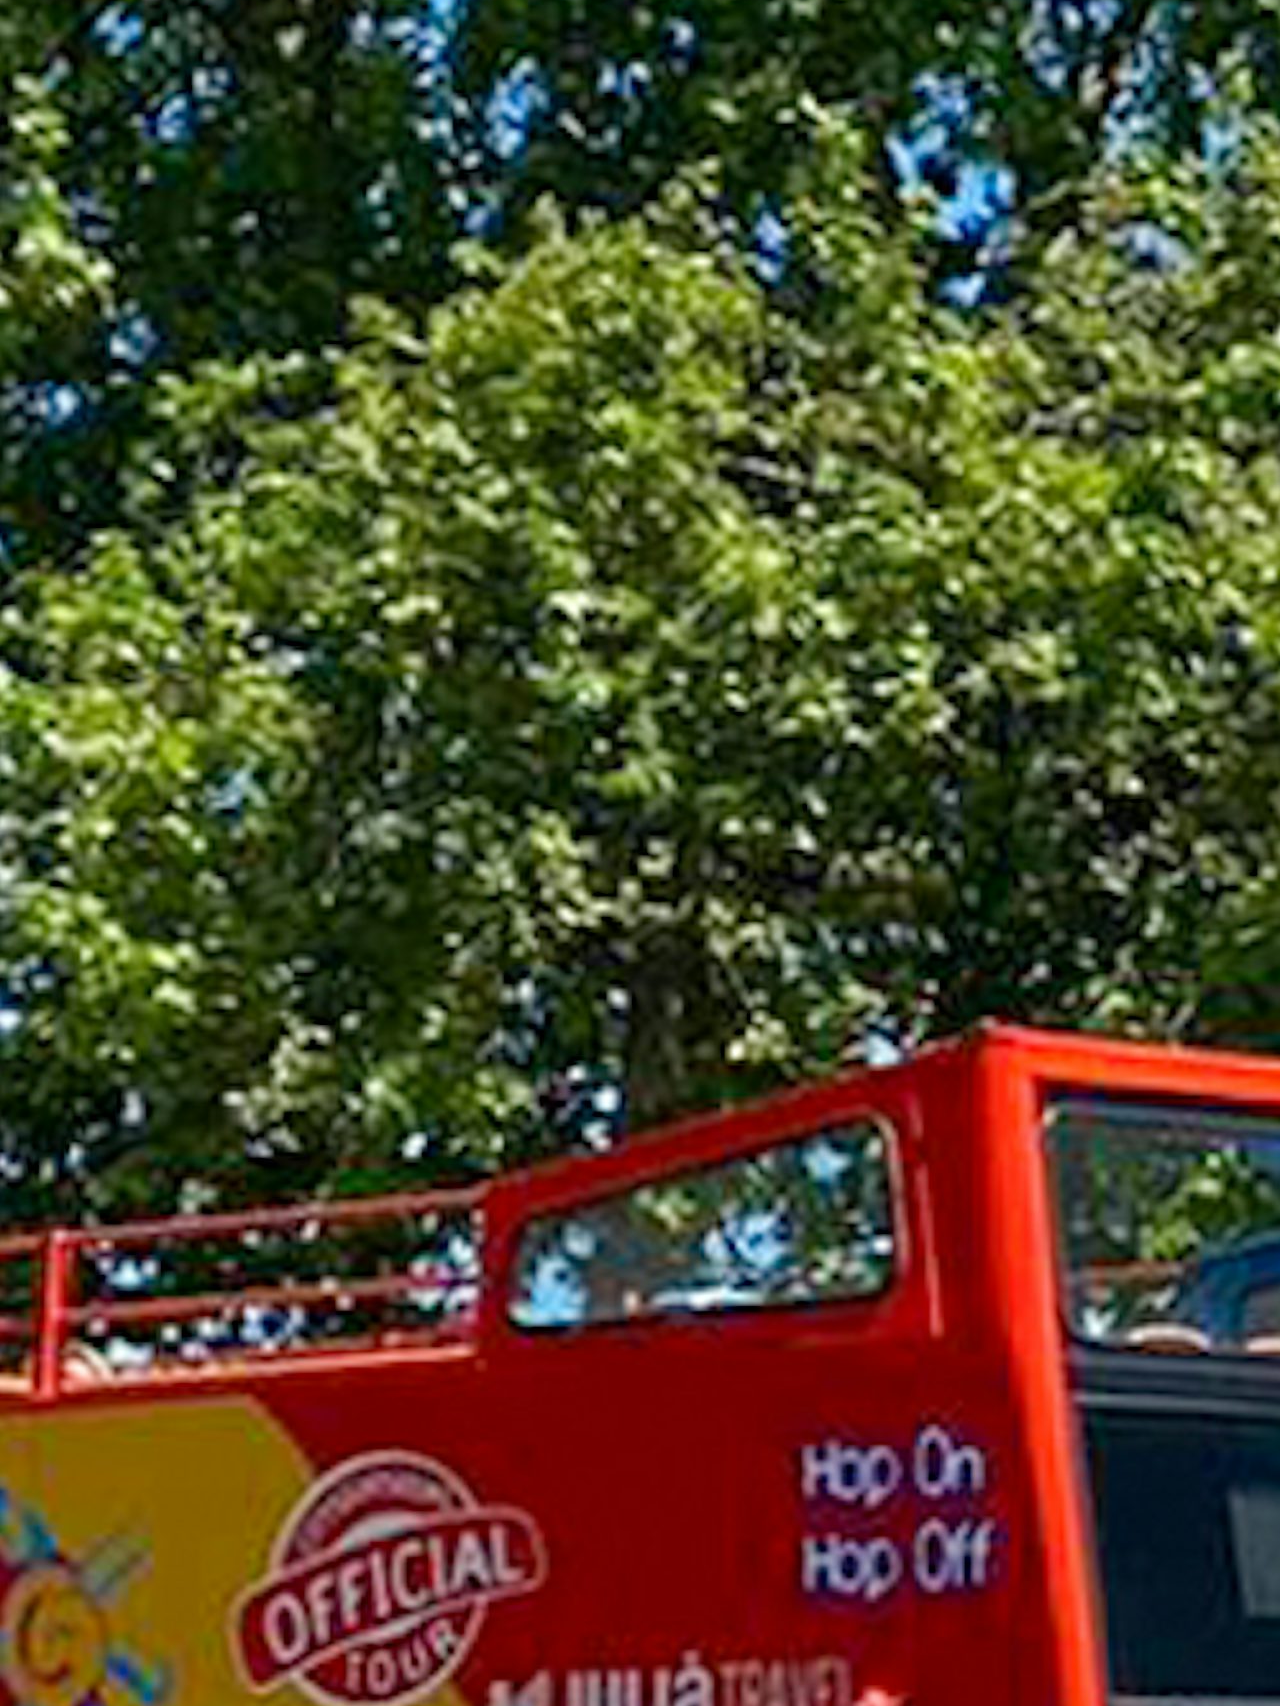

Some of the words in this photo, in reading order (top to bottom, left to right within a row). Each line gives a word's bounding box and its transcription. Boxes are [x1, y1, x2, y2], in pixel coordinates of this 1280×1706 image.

[801, 1441, 902, 1510] Hop
[914, 1424, 987, 1496] On
[262, 1523, 524, 1664] OFFICIAL
[801, 1534, 902, 1603] Hop
[914, 1517, 997, 1594] Off
[346, 1619, 462, 1695] TOUR
